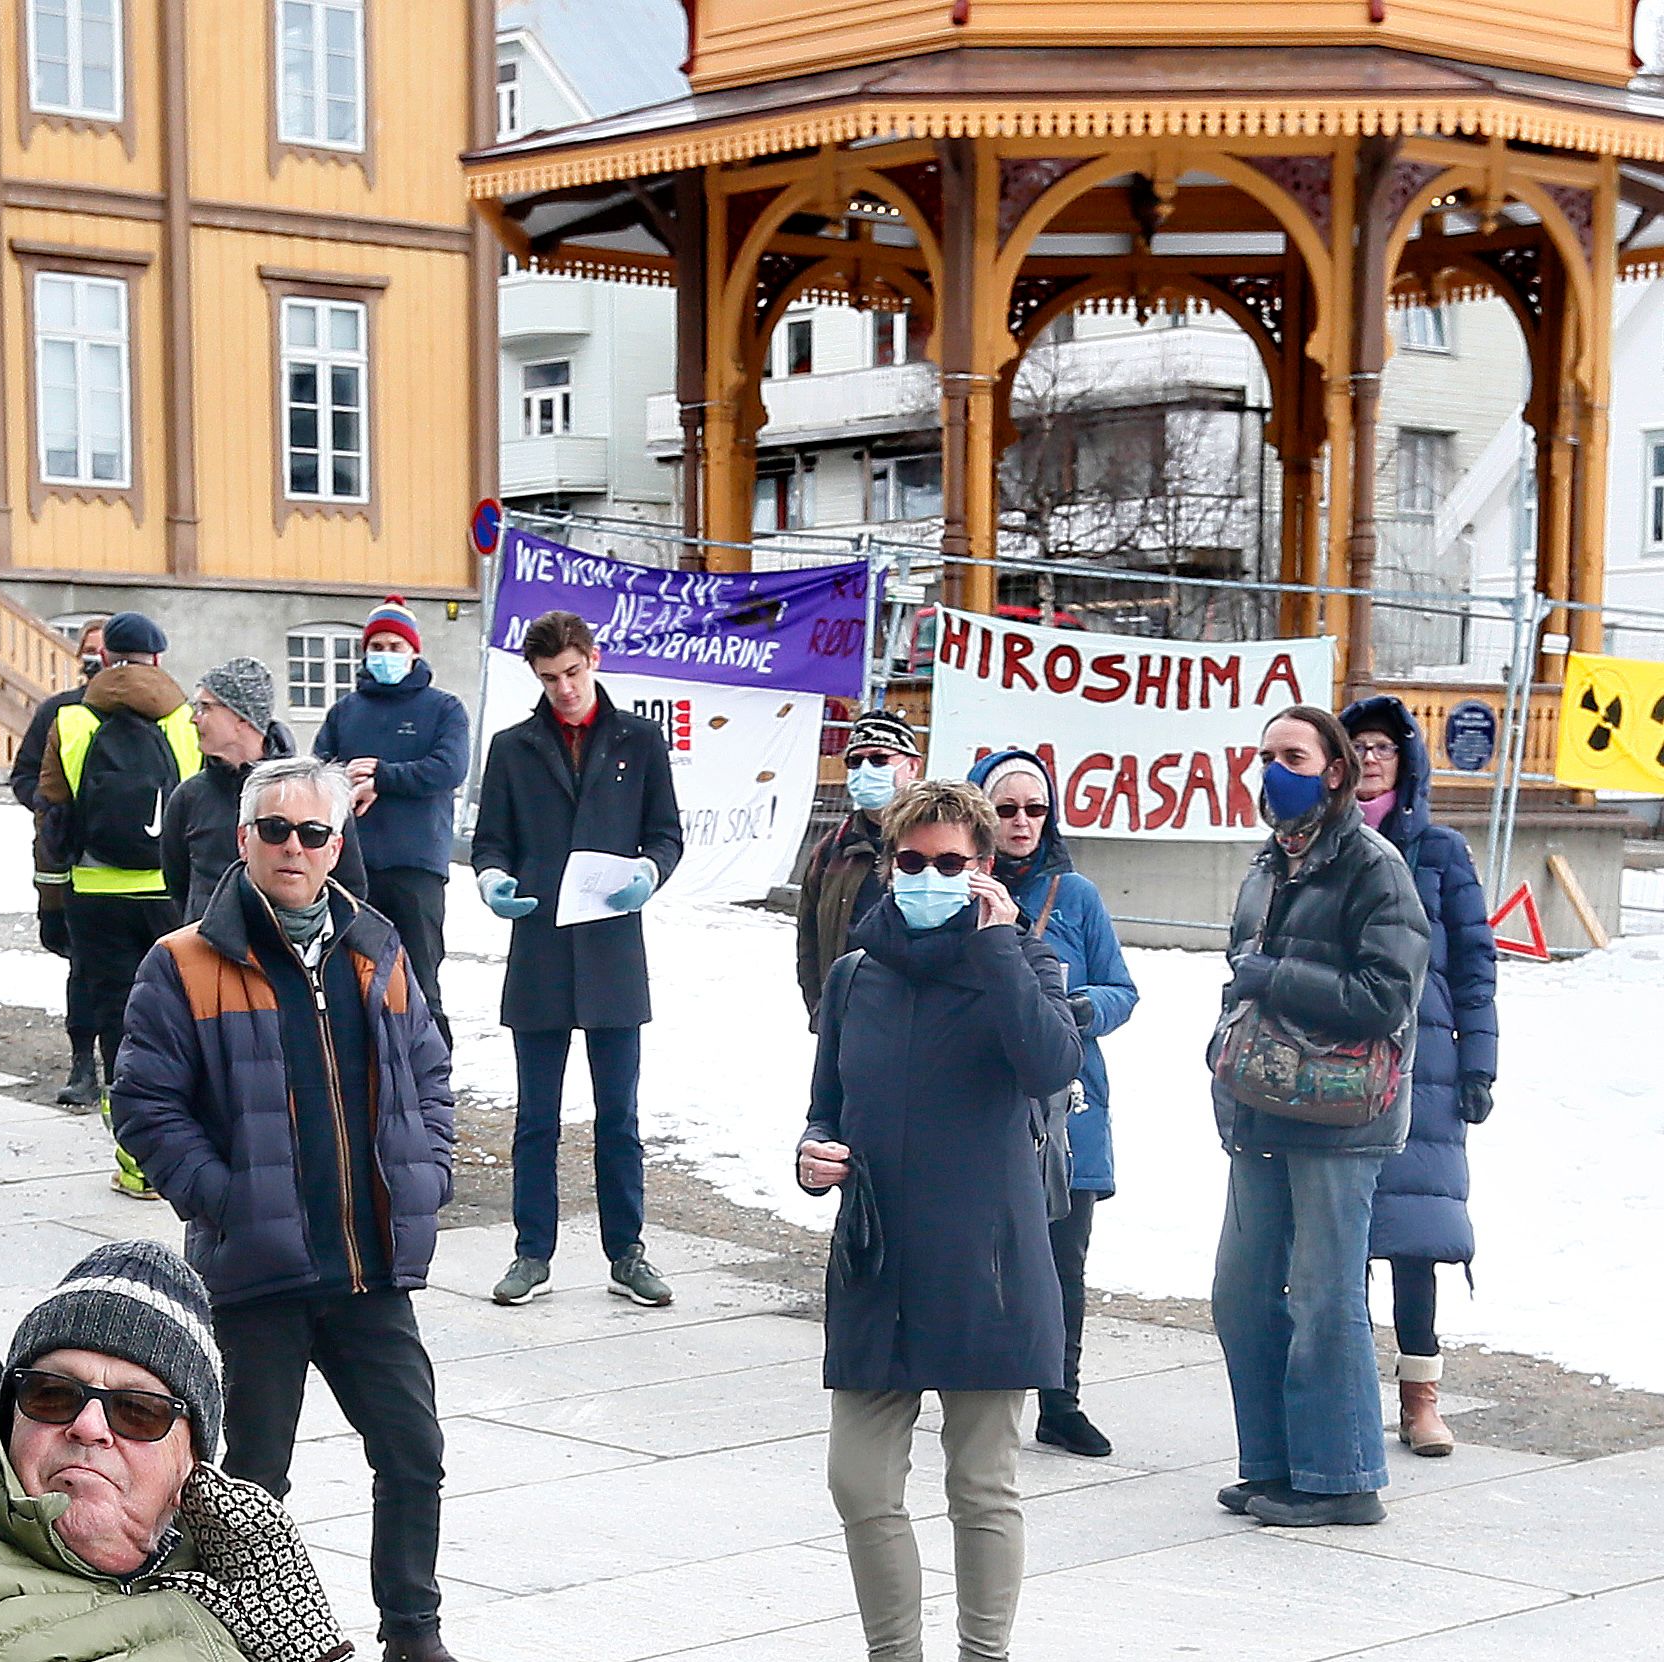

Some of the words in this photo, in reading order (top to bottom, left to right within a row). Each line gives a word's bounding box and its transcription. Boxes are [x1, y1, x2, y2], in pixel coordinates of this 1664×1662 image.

[515, 539, 555, 583] WE
[657, 571, 734, 609] LIVE
[609, 592, 693, 636] NEAR
[626, 632, 781, 675] SUBMARINE
[938, 612, 1302, 711] HIROSHIMA
